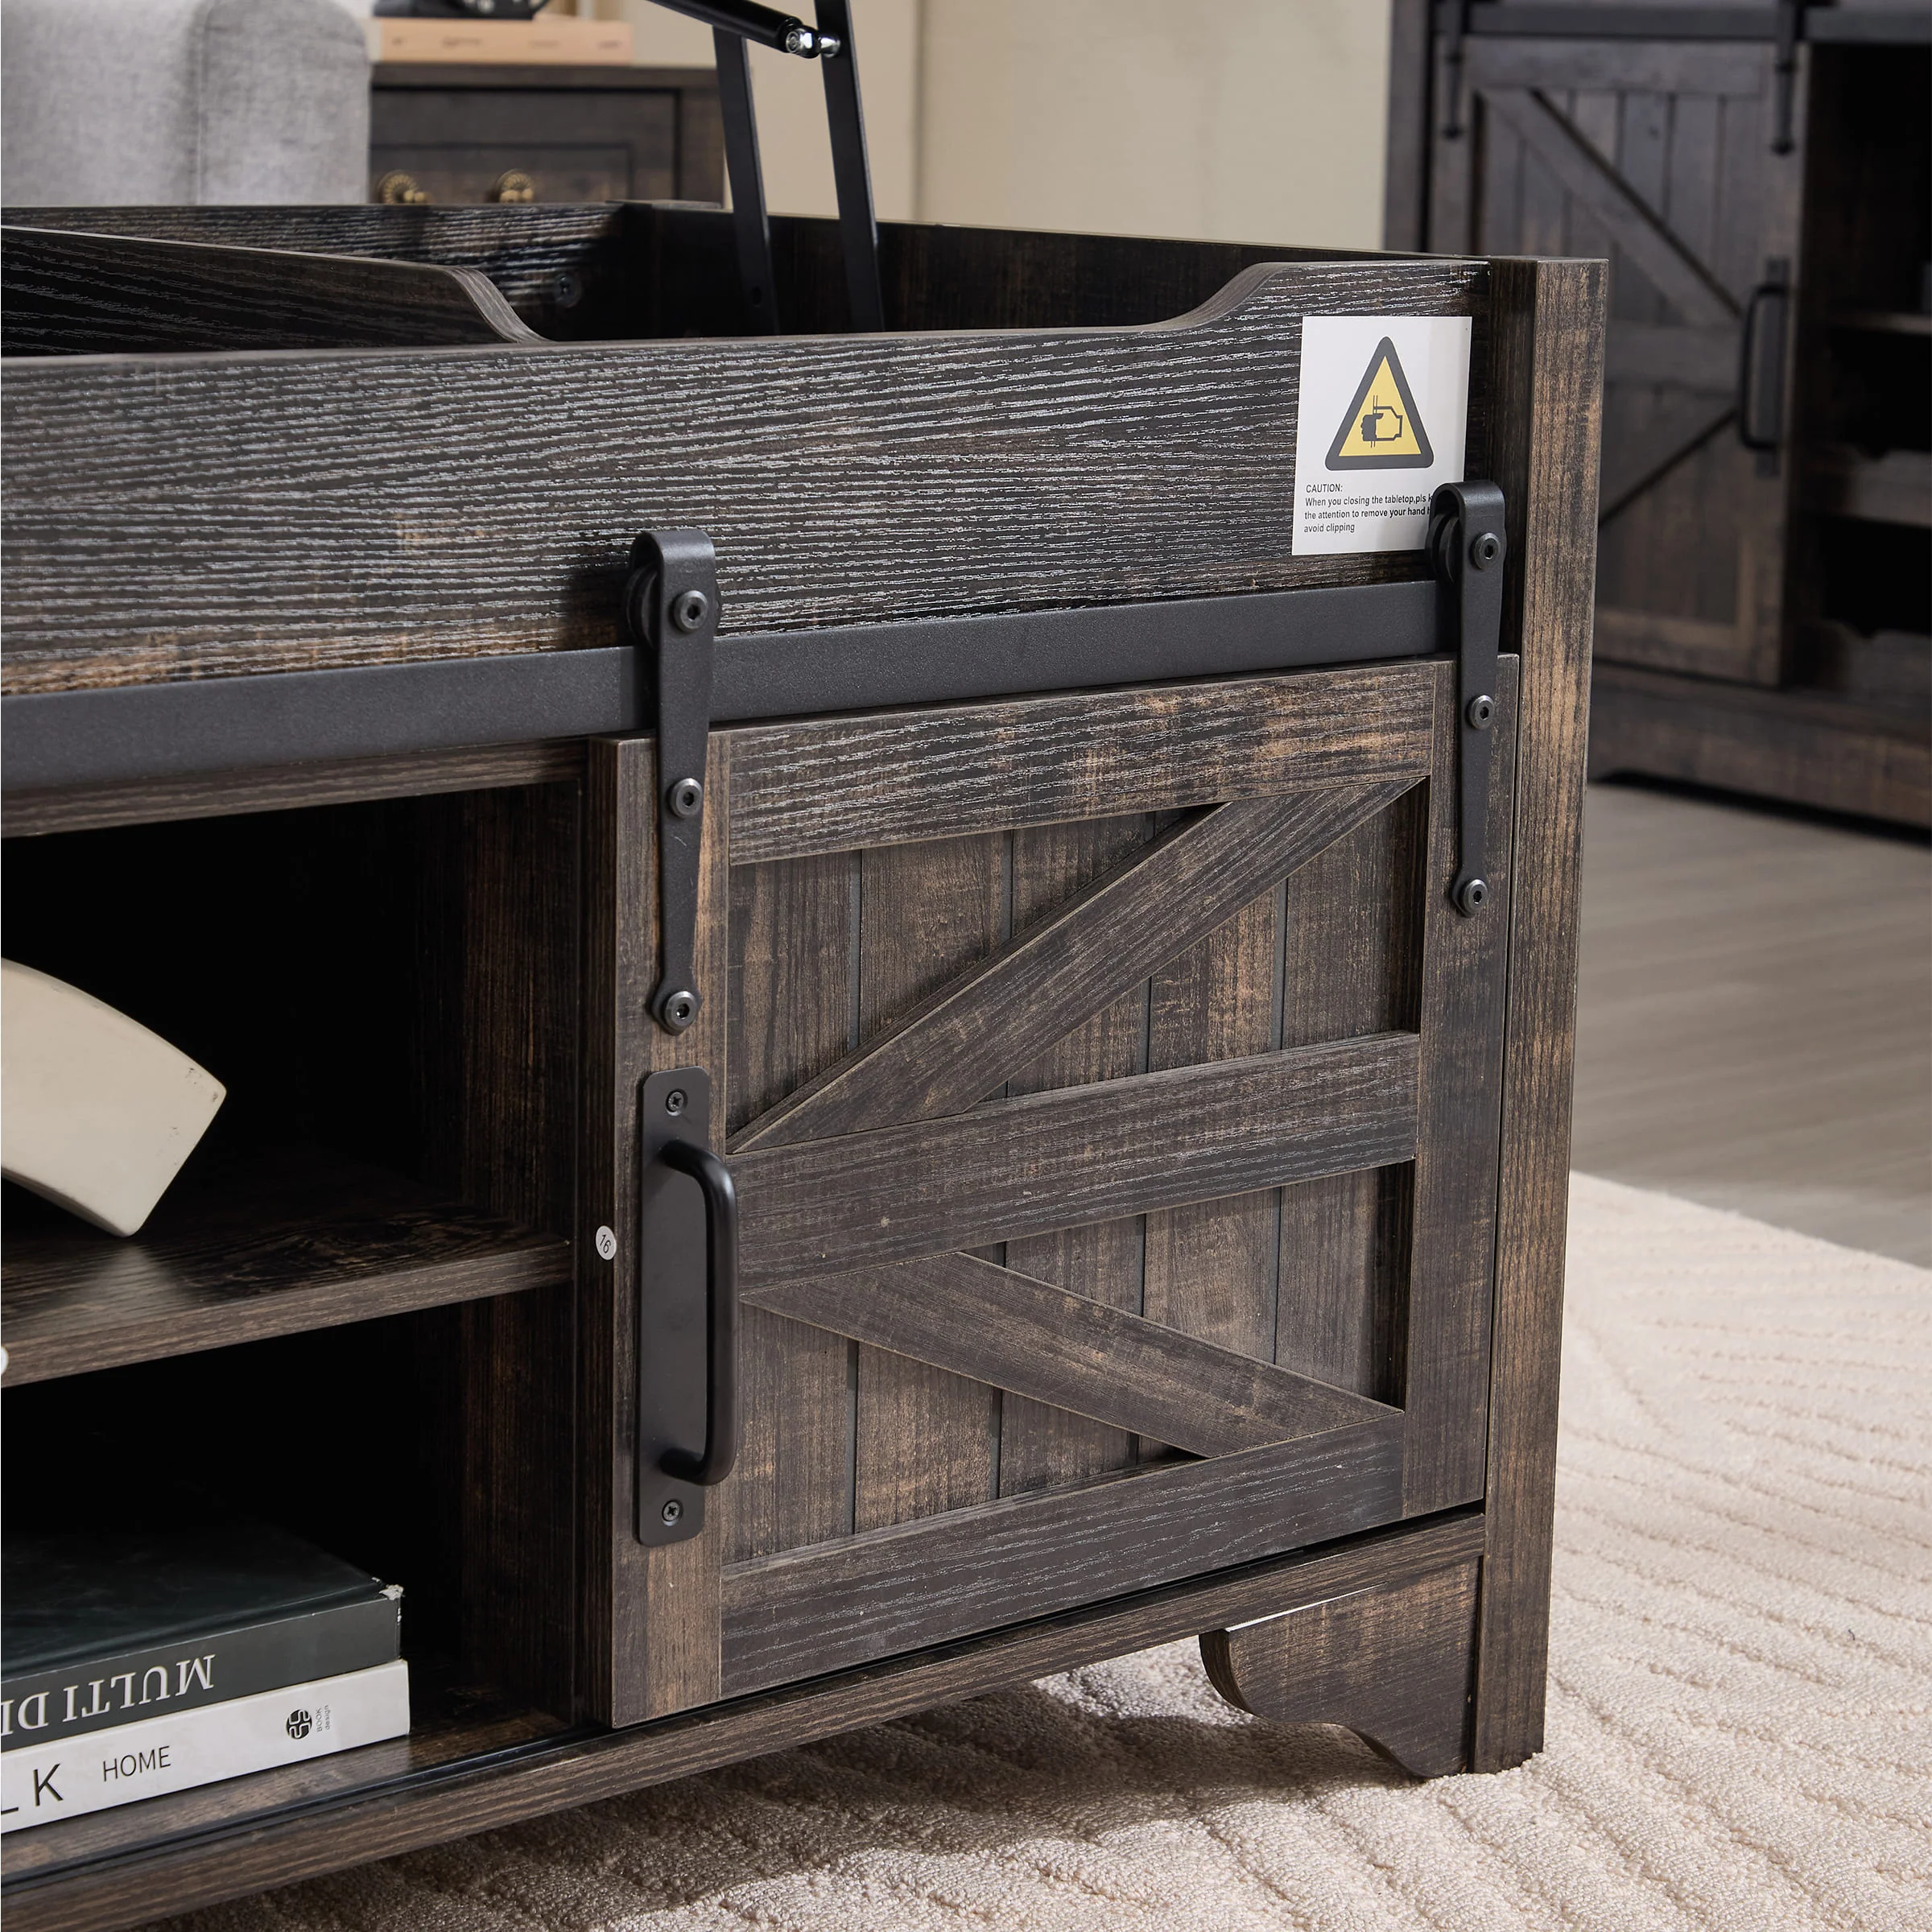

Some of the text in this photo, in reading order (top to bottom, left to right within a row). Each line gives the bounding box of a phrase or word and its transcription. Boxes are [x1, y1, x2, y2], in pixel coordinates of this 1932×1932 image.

[1306, 484, 1343, 493] CAUTION:
[1305, 497, 1326, 506] When
[1327, 497, 1342, 508] you
[1343, 495, 1370, 506] closing
[1371, 495, 1383, 504] the
[1385, 493, 1426, 505] tabletop,pls
[1304, 510, 1316, 519] the
[1318, 510, 1350, 519] attention
[1352, 510, 1360, 518] to
[1360, 509, 1388, 518] remove
[1389, 508, 1406, 518] your
[1407, 506, 1426, 516] hand
[1303, 522, 1356, 534] avoid clipping
[599, 1233, 612, 1254] 16
[61, 1653, 217, 1724] MULTI
[315, 1707, 323, 1733] BOOK
[102, 1745, 172, 1782] HOME
